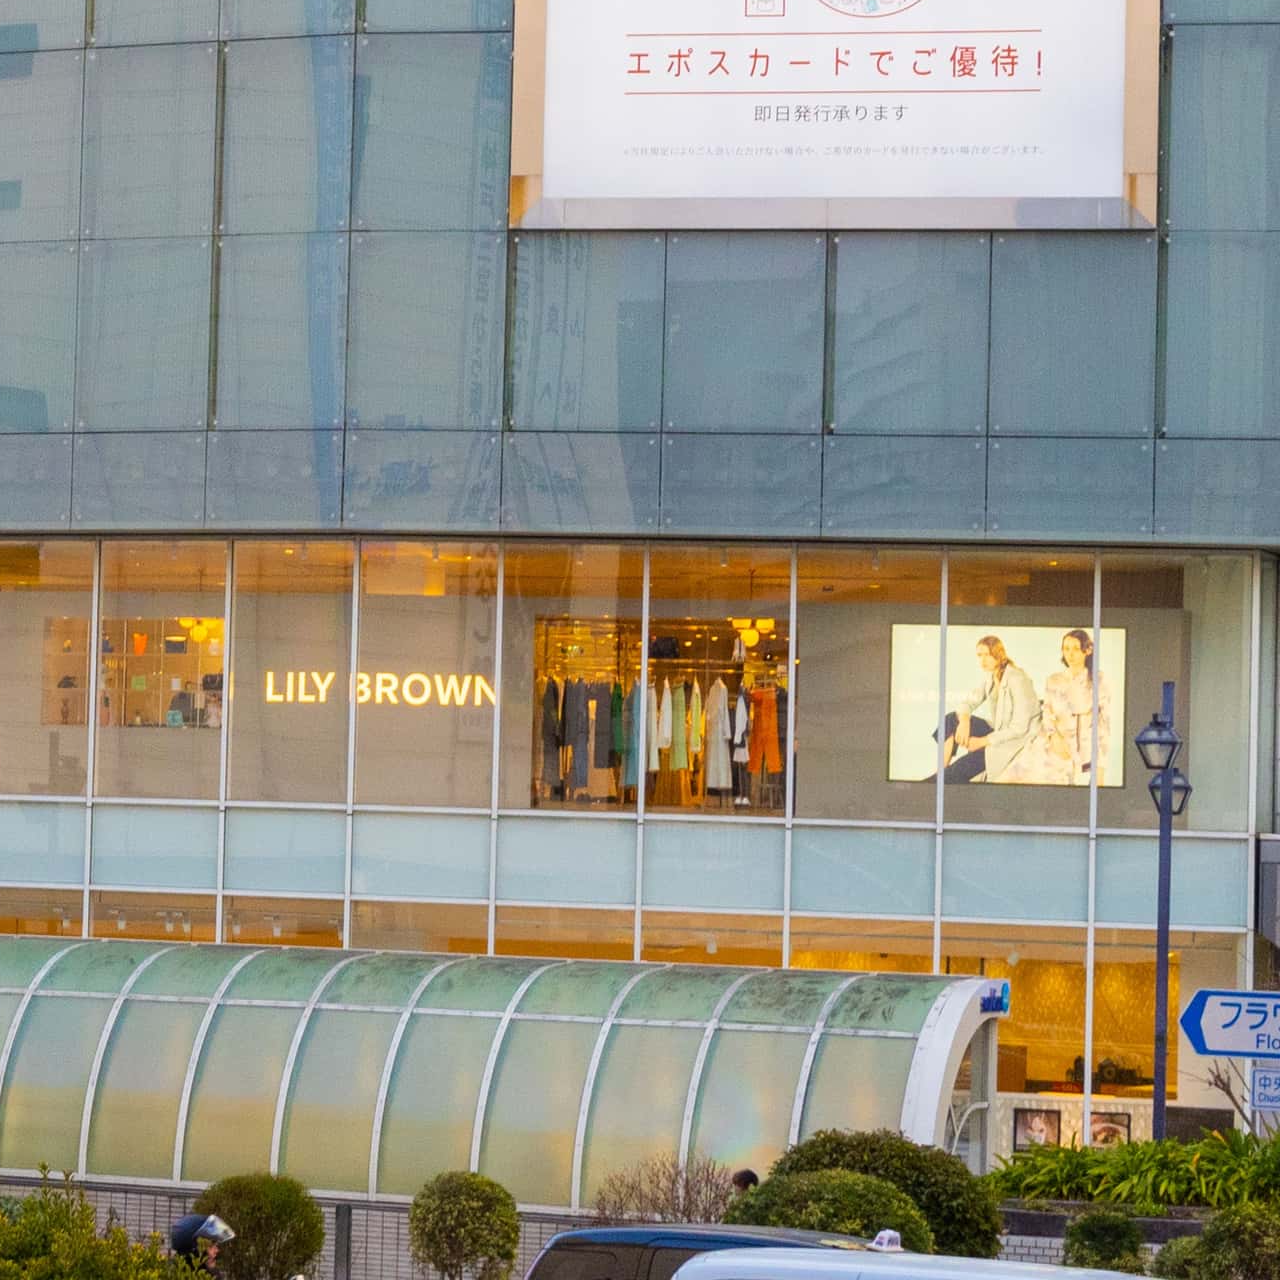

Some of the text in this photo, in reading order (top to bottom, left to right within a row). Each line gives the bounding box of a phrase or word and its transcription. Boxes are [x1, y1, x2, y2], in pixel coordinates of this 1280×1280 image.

[753, 103, 909, 122] 即日発行承ります
[265, 671, 497, 707] LILY BROWN
